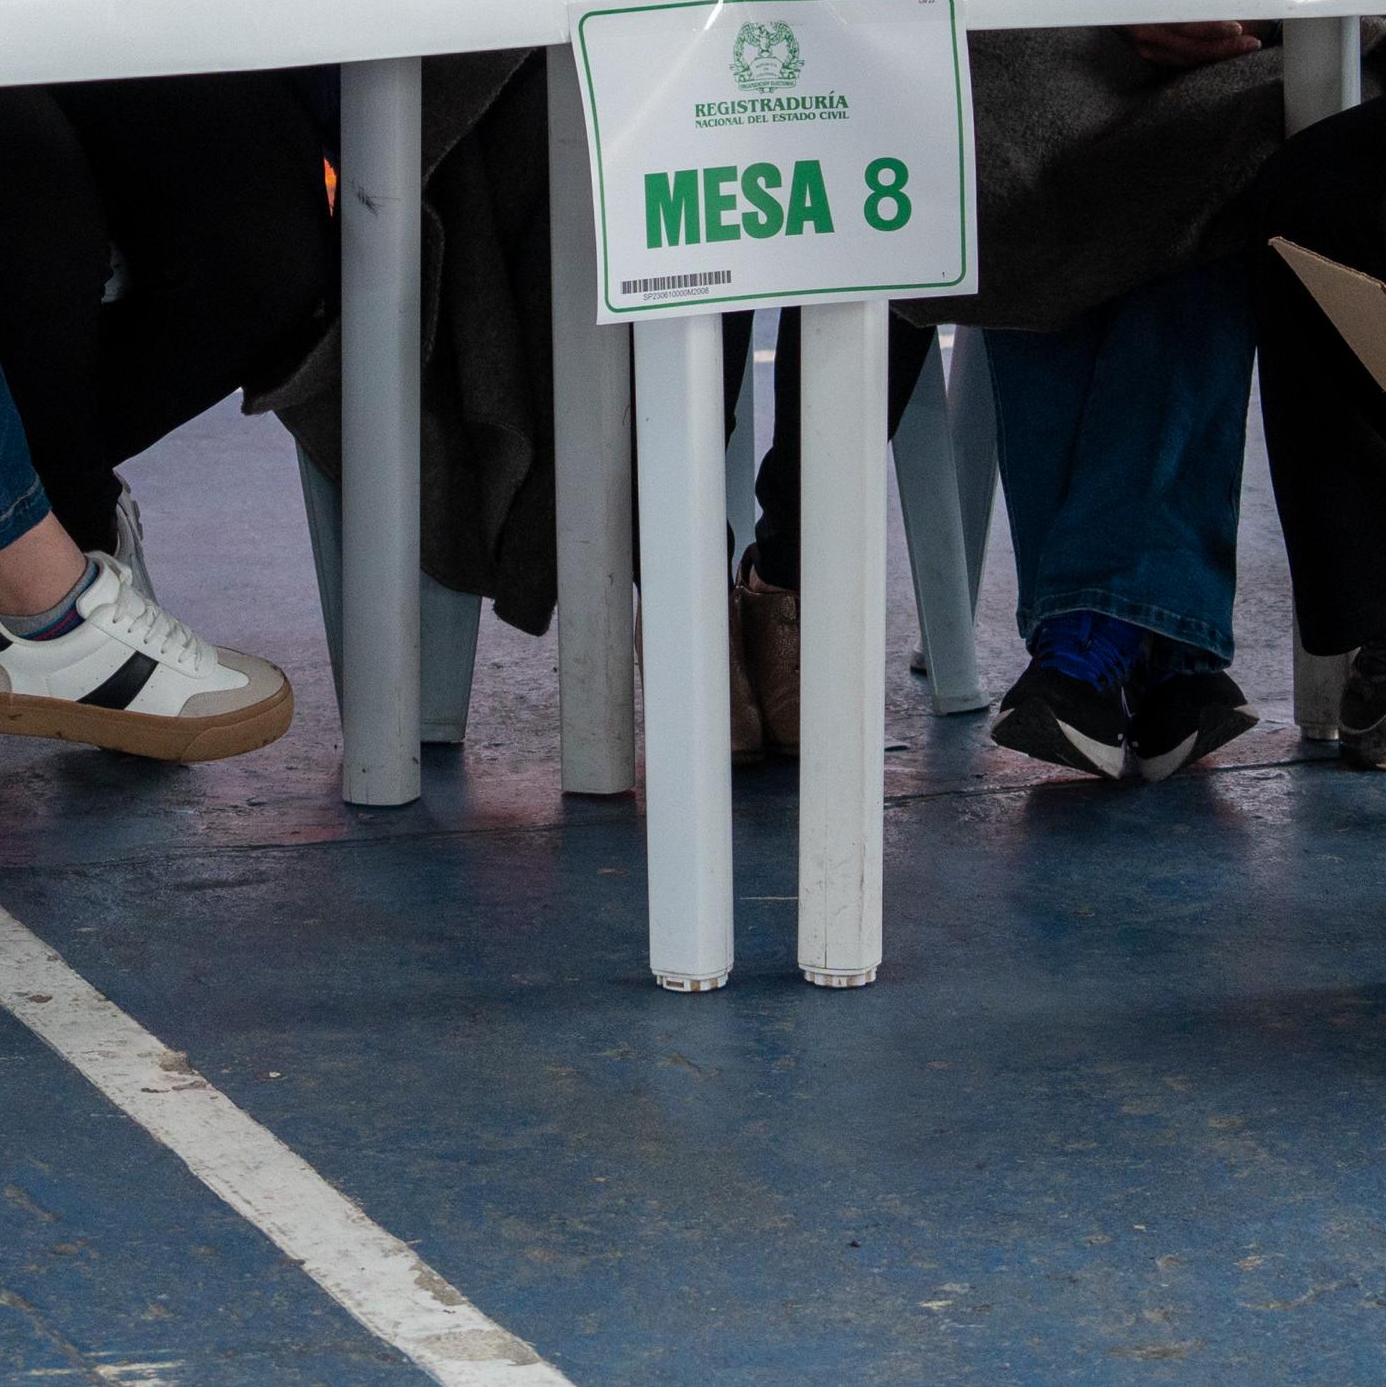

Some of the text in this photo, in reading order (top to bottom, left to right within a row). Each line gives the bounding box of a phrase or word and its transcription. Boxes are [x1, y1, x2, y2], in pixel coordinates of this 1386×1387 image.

[695, 91, 849, 117] REGISTRADURÍA
[695, 111, 849, 128] NACIONAL DEL ESTADO CIVIL
[644, 157, 912, 249] MESA 8
